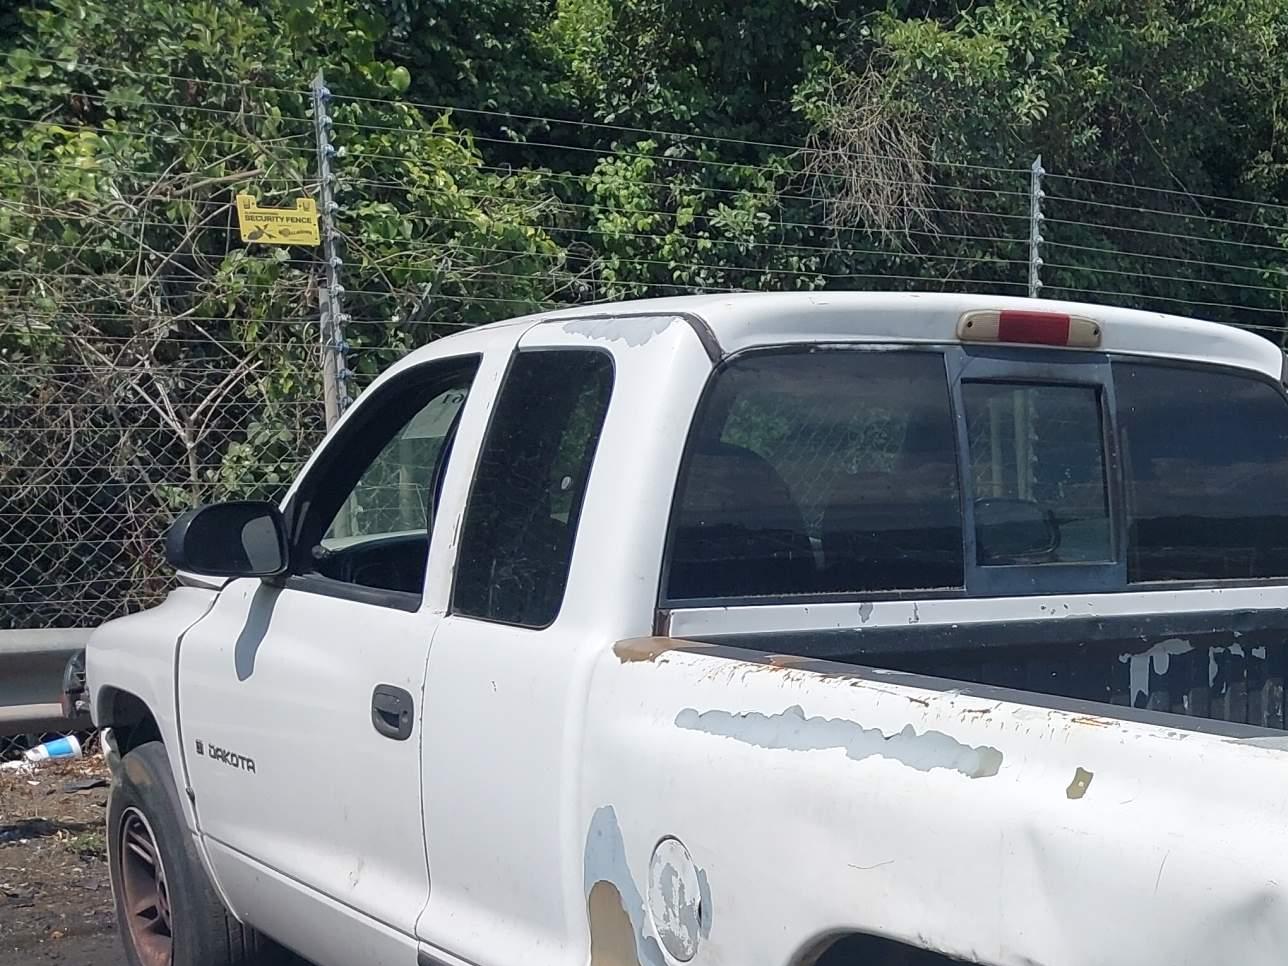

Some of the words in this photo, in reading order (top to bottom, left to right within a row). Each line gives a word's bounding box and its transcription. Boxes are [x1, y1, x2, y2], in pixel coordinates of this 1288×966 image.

[244, 214, 285, 223] SECURITY
[286, 216, 312, 224] FENCE
[208, 743, 256, 774] DAKOTA
